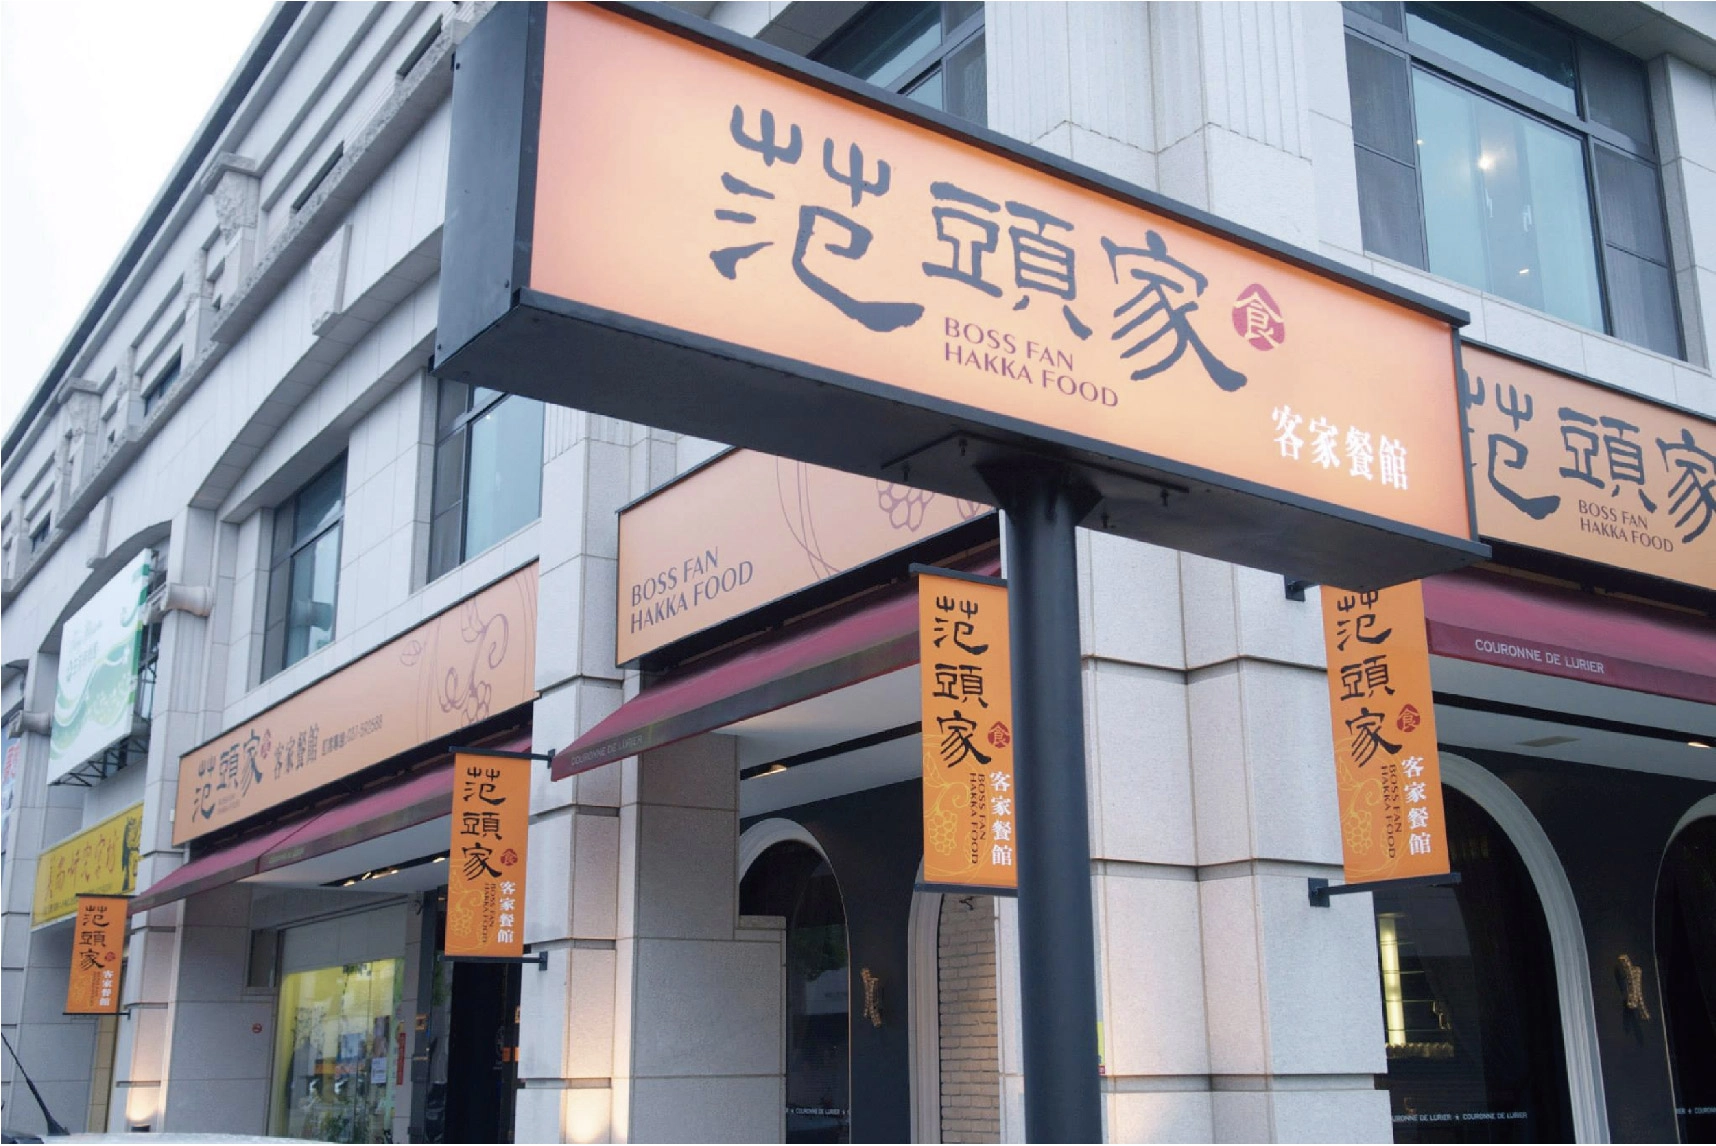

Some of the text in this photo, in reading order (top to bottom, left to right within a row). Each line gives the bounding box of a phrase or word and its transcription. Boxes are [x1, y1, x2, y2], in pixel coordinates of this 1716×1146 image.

[709, 103, 1247, 392] 范頭家
[944, 316, 1074, 372] BOSS FAN
[1232, 284, 1285, 351] 食
[944, 341, 1119, 407] HAKKA FOOD
[1271, 404, 1409, 490] 客家餐館
[1578, 499, 1648, 529] BOSS FAN
[1580, 516, 1674, 552] HAKKA FOOD
[630, 560, 754, 634] HAKKA FOOD
[631, 546, 719, 607] BOSS FAN
[932, 595, 992, 768] 范頭家
[1475, 639, 1605, 674] COURONNE DE LURIER
[987, 720, 1011, 749] 食
[1396, 703, 1421, 732] 食
[969, 772, 979, 865] HAKKA FOOD
[978, 773, 986, 811] BOSS
[989, 770, 1013, 866] 客家餐館
[1381, 765, 1395, 858] HAKKA FOOD
[1389, 764, 1402, 832] BOSS FAN
[1401, 755, 1432, 856] 客家餐館
[498, 880, 516, 943] 客家餐館
